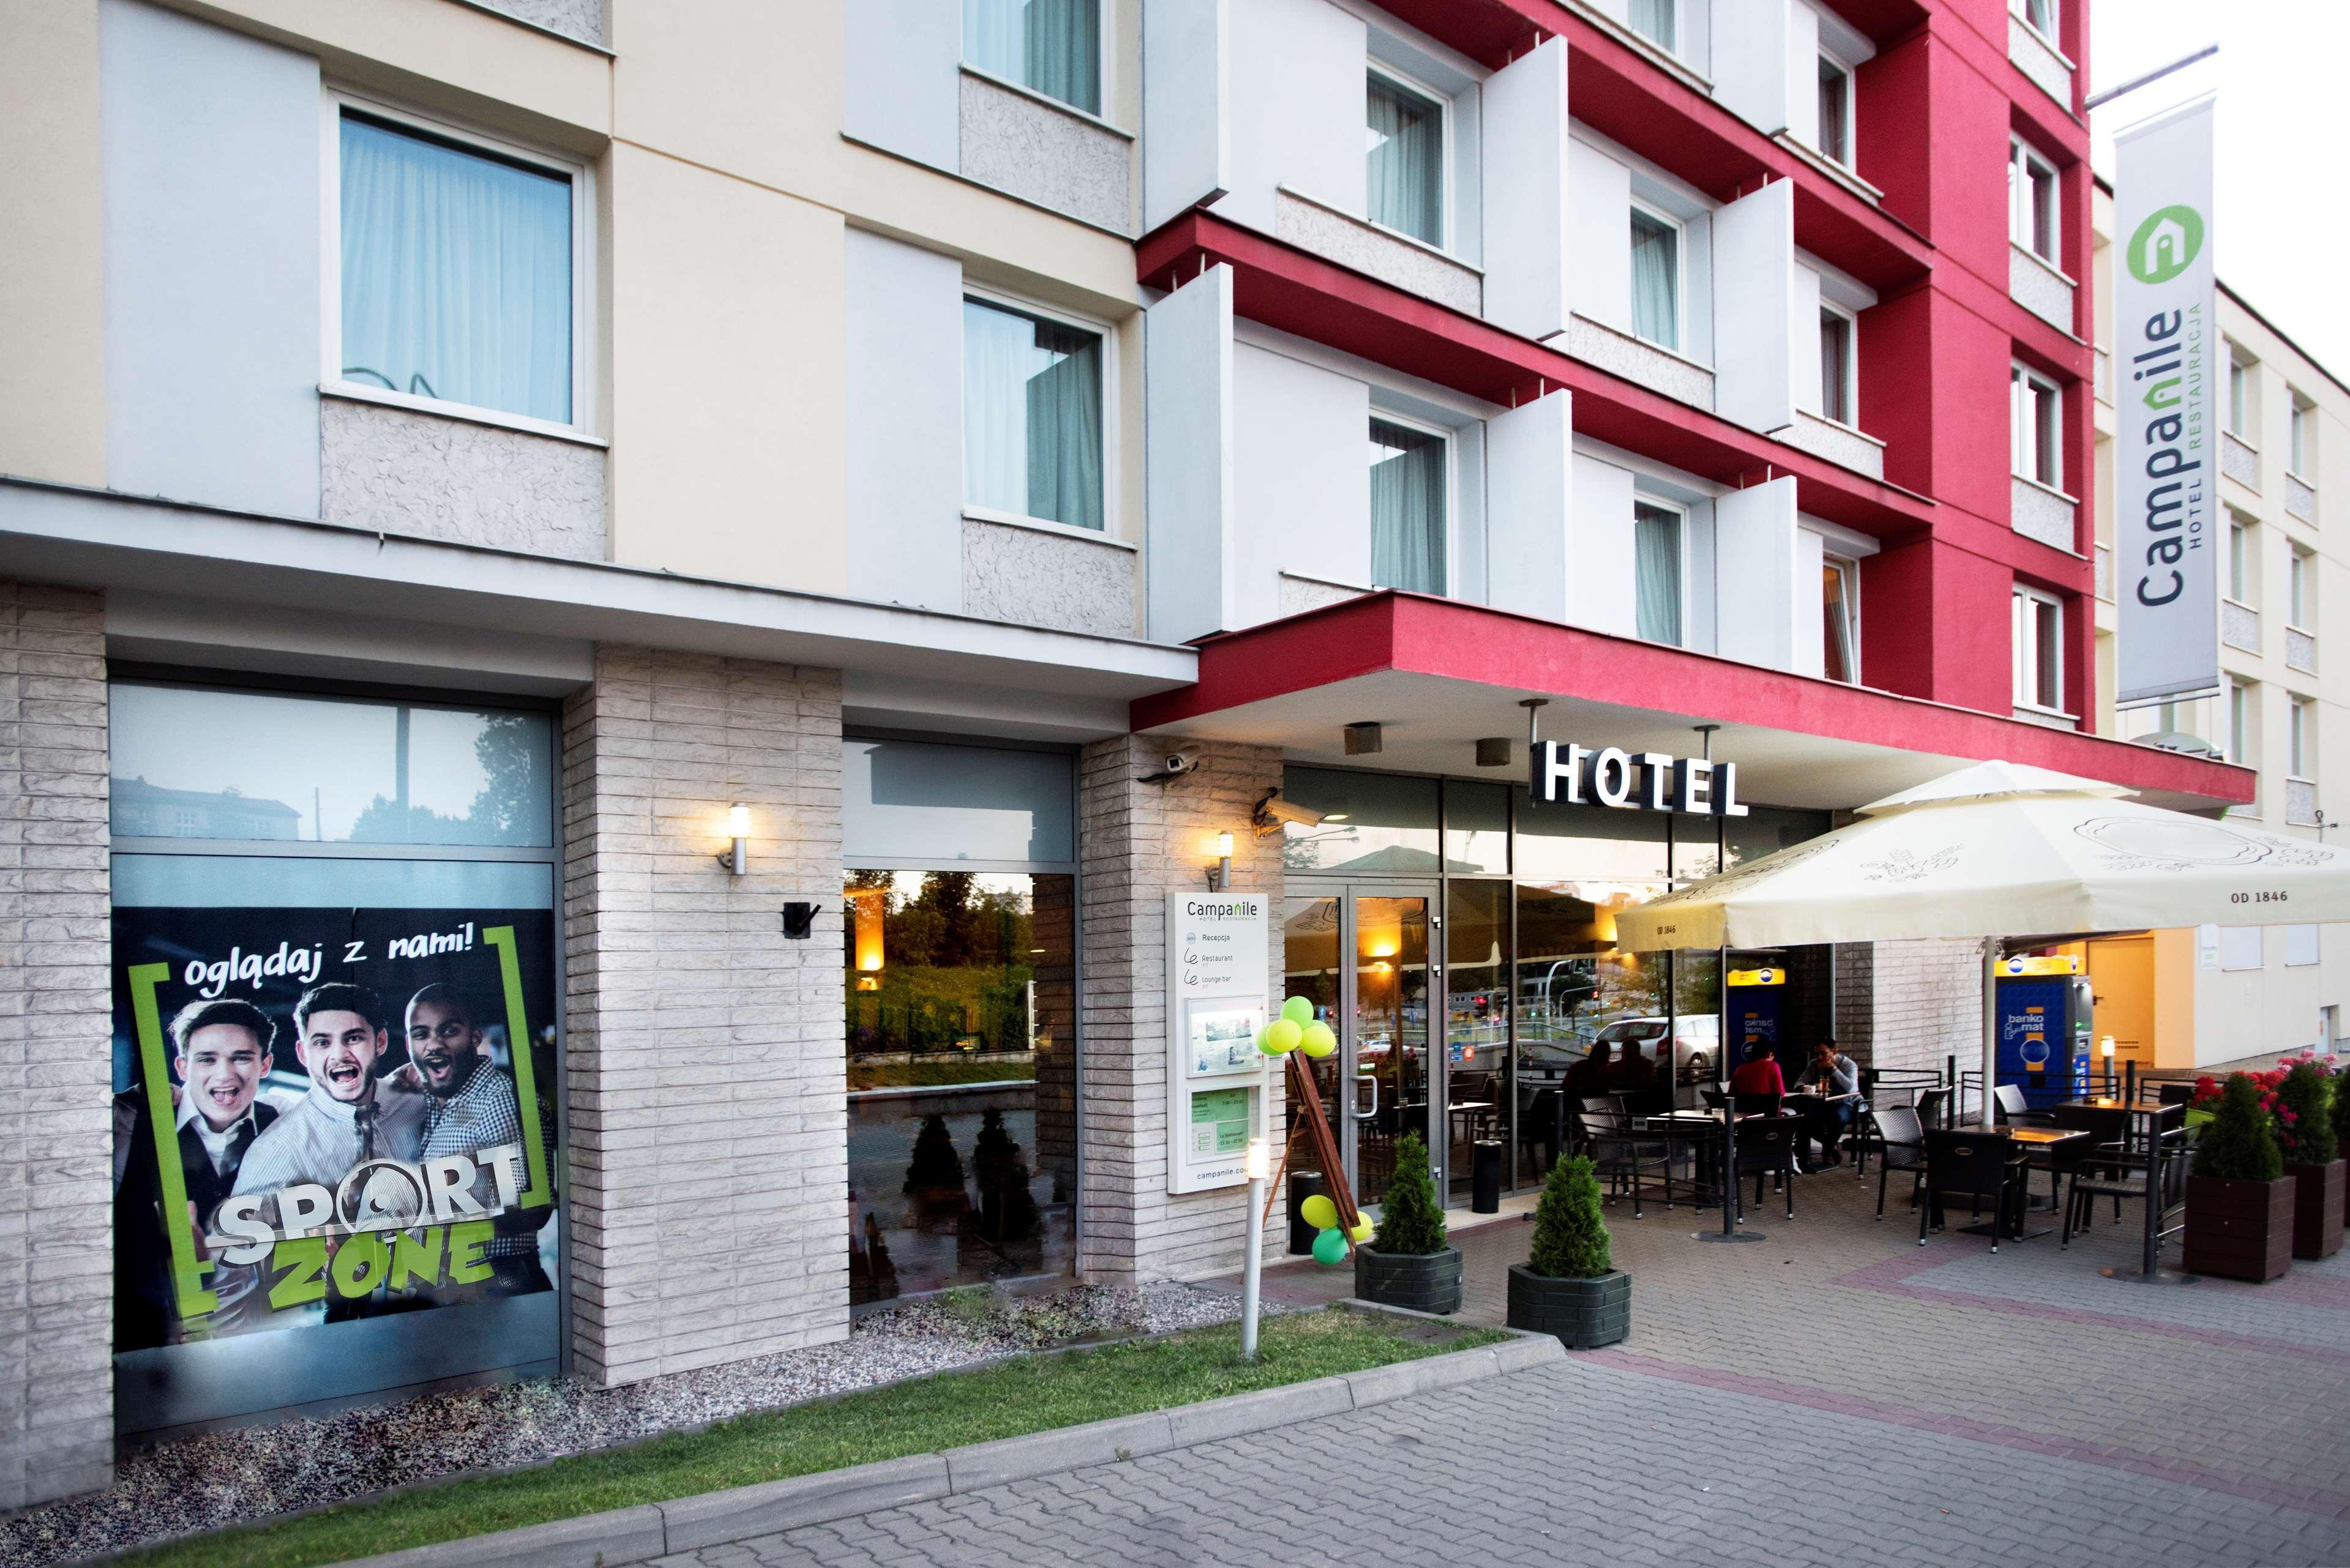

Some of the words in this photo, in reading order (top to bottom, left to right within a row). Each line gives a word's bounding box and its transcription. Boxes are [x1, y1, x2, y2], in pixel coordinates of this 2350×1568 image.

[2188, 302, 2202, 450] RESTAURACJA
[2133, 308, 2201, 607] Campanile
[2189, 478, 2202, 550] HOTEL
[1532, 740, 1749, 816] HOTEL
[1188, 902, 1257, 920] Campanile
[2230, 893, 2249, 903] OD
[2255, 890, 2288, 902] 1846
[184, 941, 323, 998] oglądaj
[343, 941, 367, 963] z
[387, 922, 474, 960] nami!
[1202, 934, 1230, 943] Recepcja
[2008, 1014, 2044, 1023] banko
[2021, 1023, 2044, 1031] mat
[218, 1143, 524, 1266] SPORT
[268, 1219, 495, 1310] ZONE
